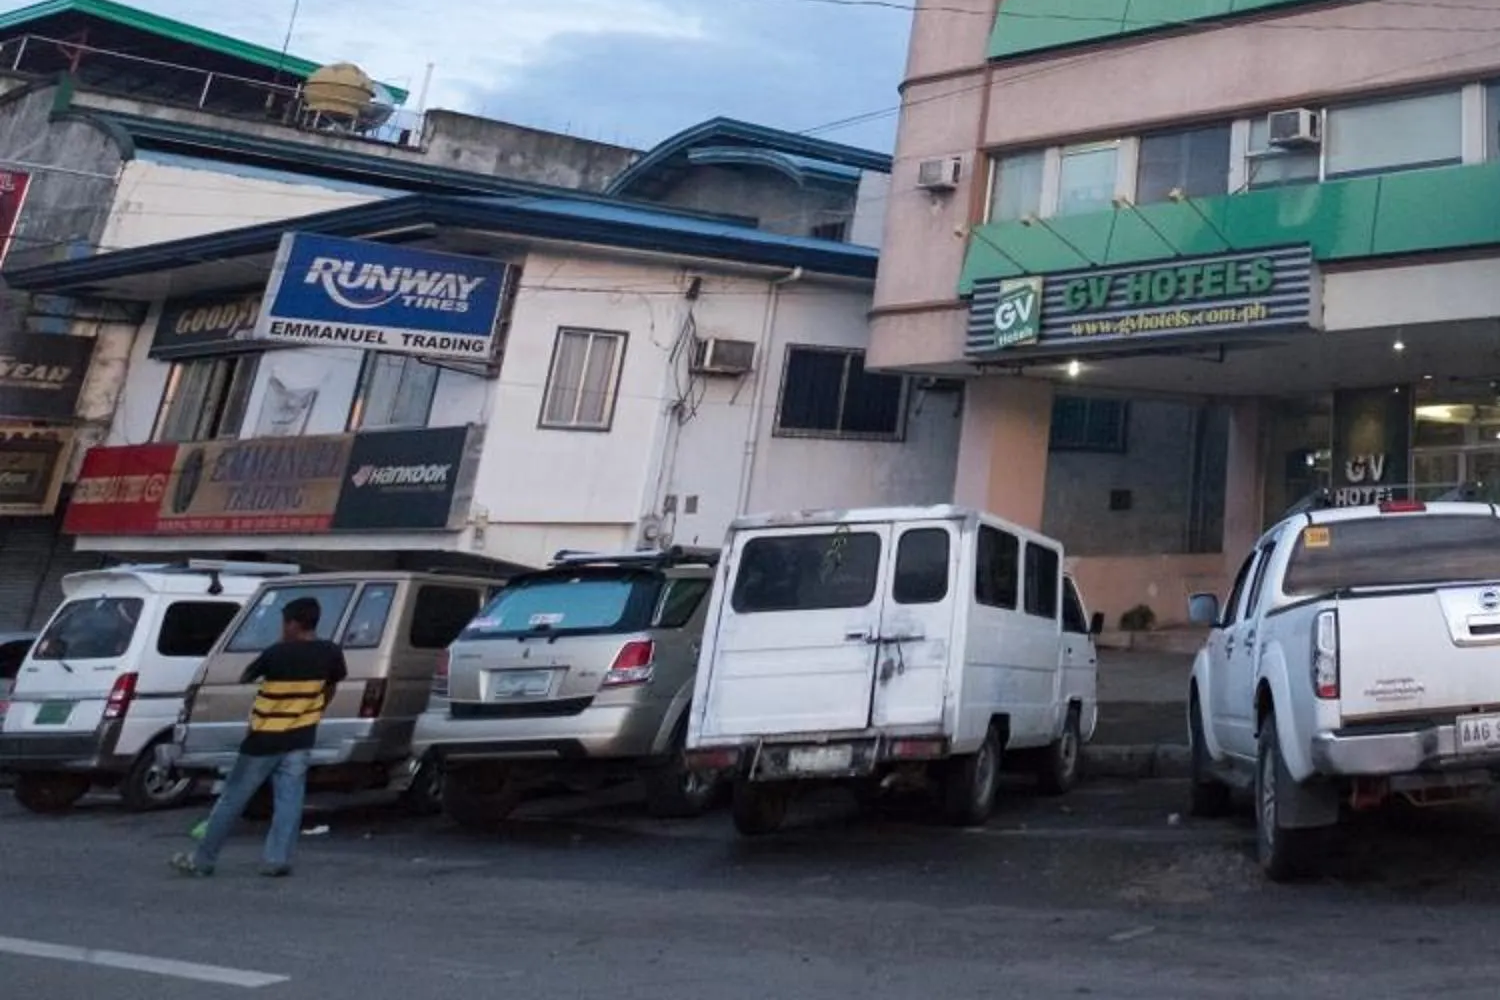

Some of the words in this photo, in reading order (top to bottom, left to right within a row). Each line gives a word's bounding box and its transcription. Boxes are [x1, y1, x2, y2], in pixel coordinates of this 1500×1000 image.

[303, 256, 486, 309] RUNWAY
[1064, 275, 1112, 312] GV
[1125, 257, 1275, 304] HOTELS
[401, 295, 469, 313] TIRES
[995, 294, 1035, 330] GV
[270, 321, 388, 345] EMMANUEL
[401, 333, 485, 352] TRADING
[1345, 453, 1385, 482] GV
